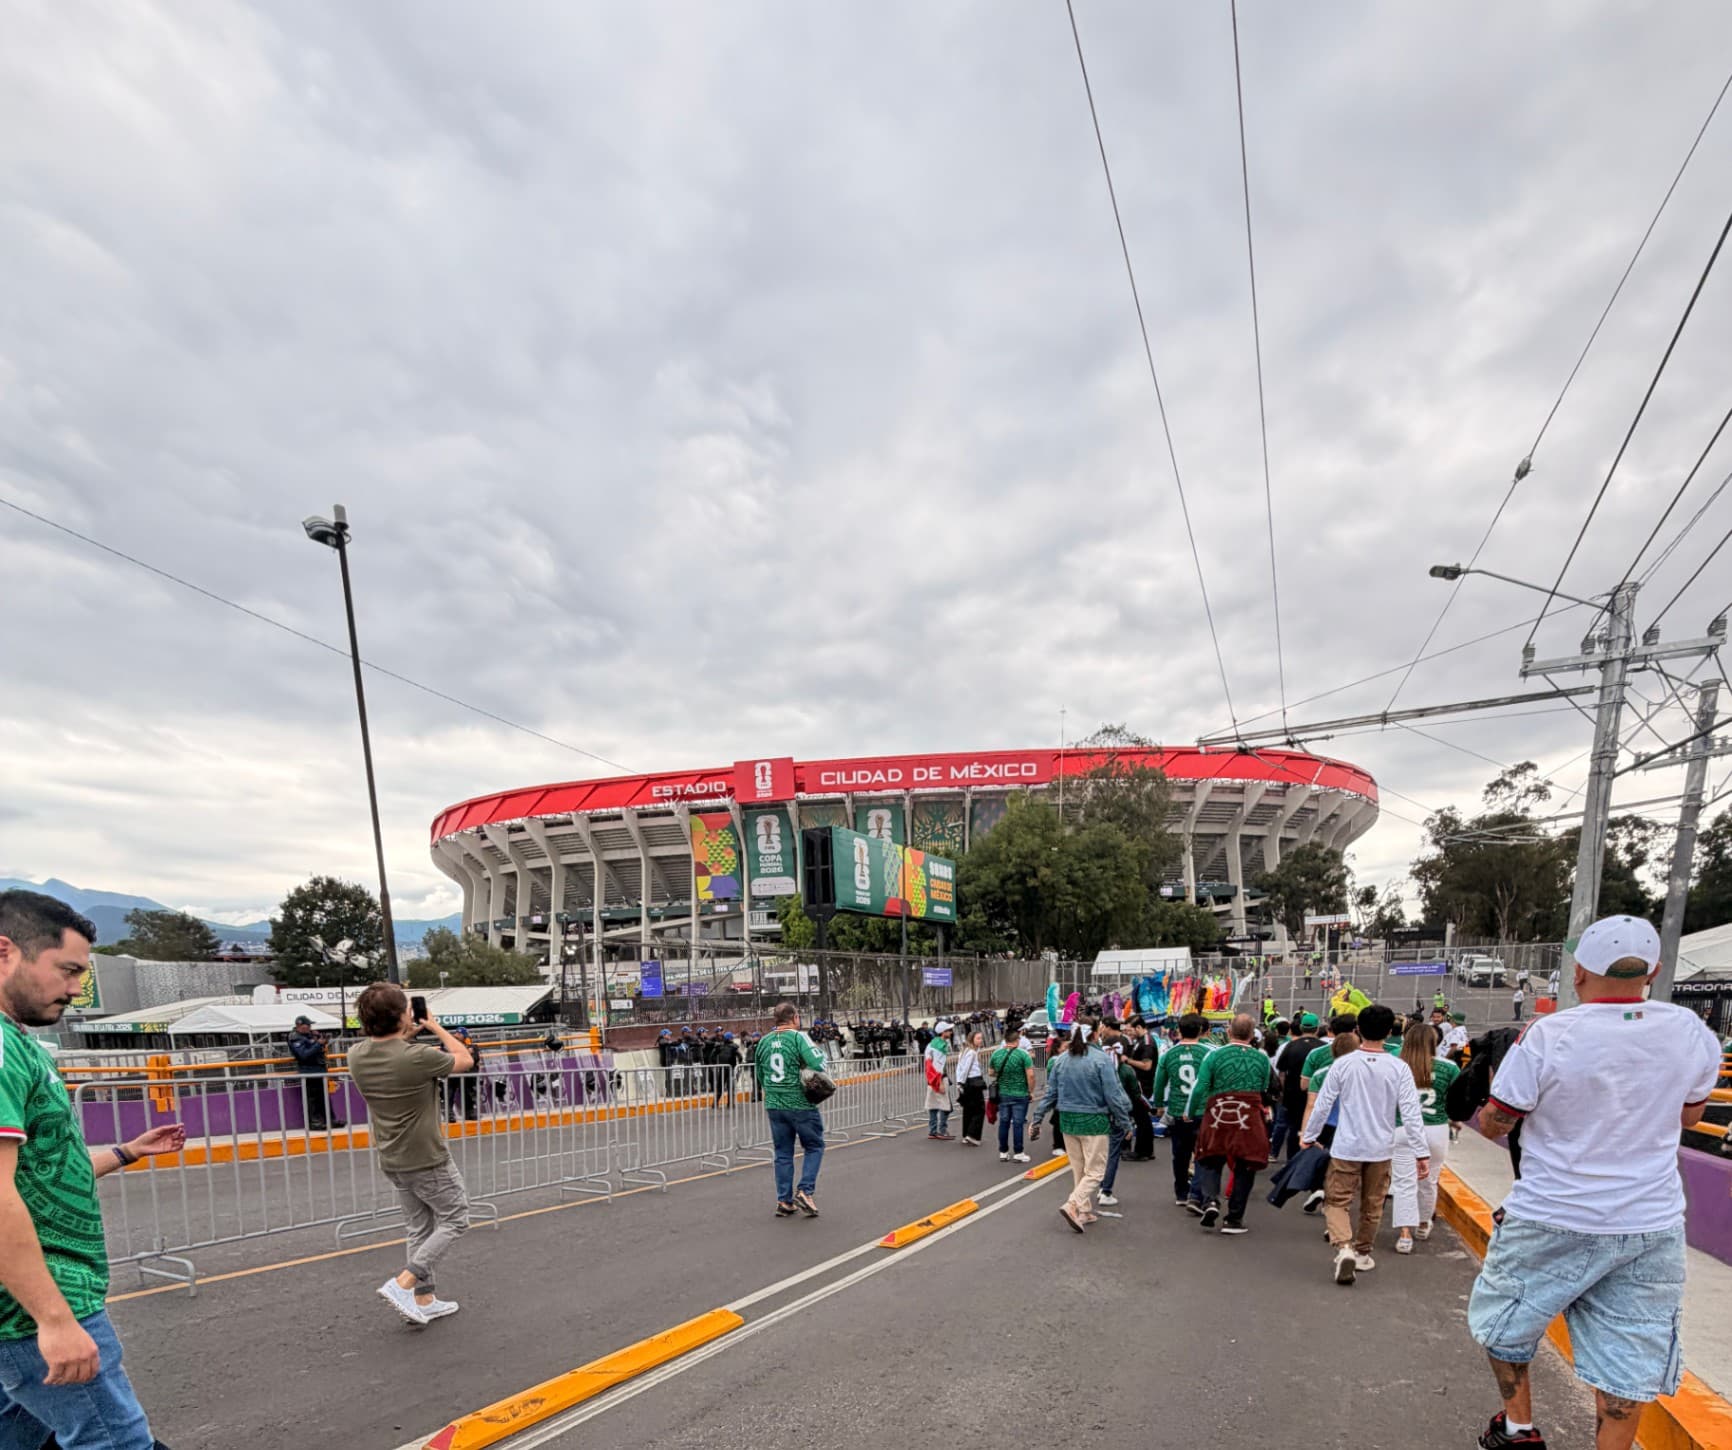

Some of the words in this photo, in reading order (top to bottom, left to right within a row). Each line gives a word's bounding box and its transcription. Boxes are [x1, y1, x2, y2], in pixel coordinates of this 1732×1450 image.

[820, 768, 903, 785] CIUDAD
[913, 767, 942, 781] DE
[950, 762, 1037, 779] MÉXICO
[652, 781, 727, 797] ESTADIO
[759, 854, 782, 862] COPA
[760, 866, 783, 874] 2026
[286, 992, 323, 1001] CIUDAD
[443, 1015, 465, 1025] CUP
[466, 1014, 505, 1024] 2026
[770, 1052, 785, 1083] 9
[1178, 1064, 1196, 1095] 9
[1418, 1087, 1437, 1115] 2
